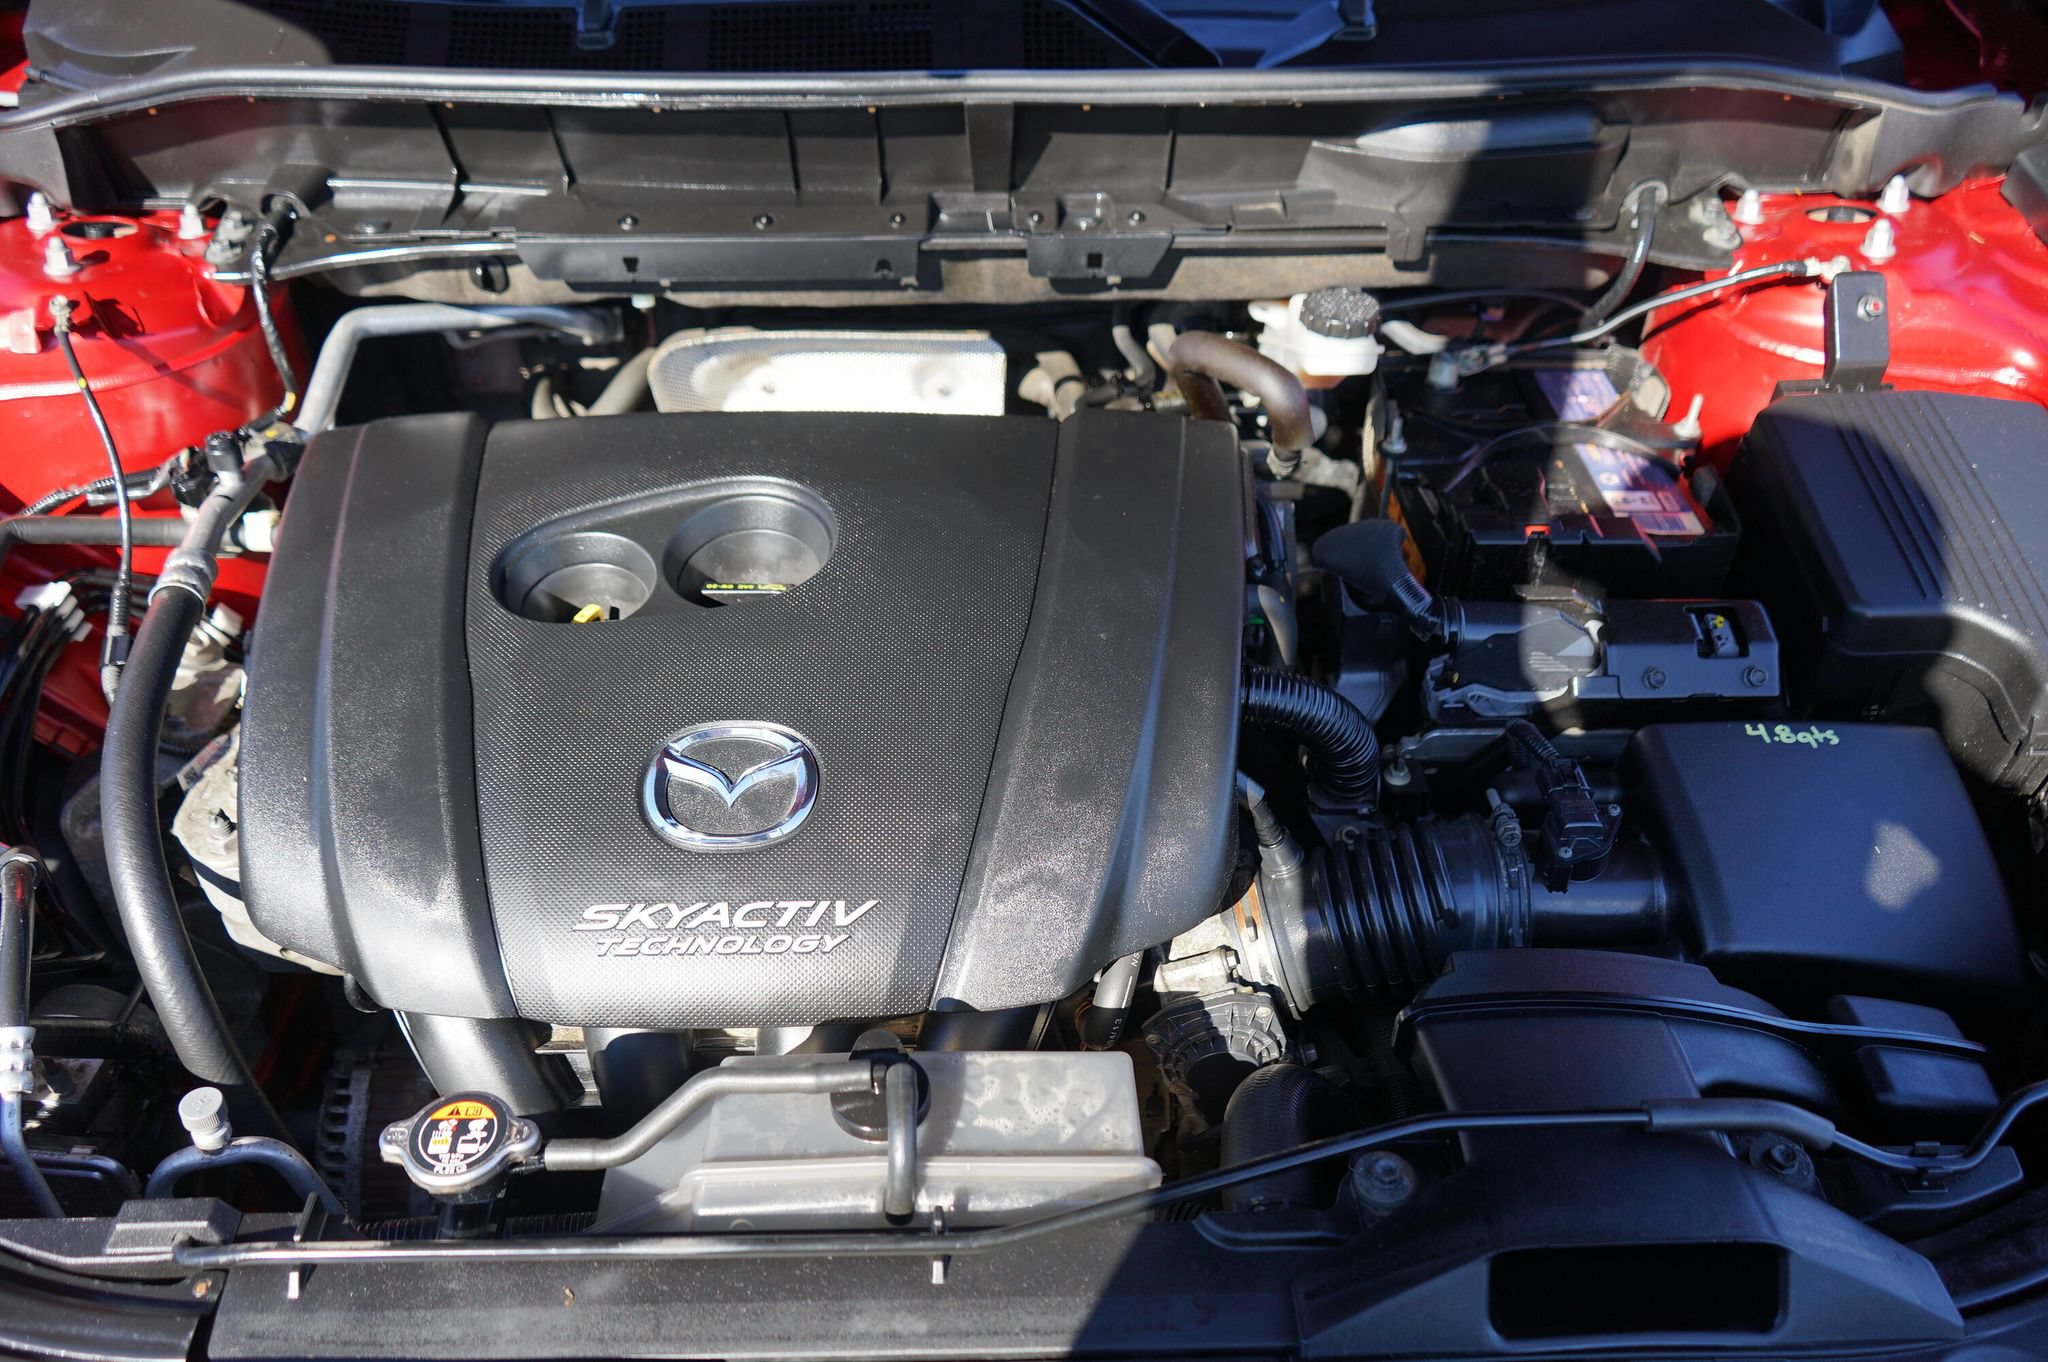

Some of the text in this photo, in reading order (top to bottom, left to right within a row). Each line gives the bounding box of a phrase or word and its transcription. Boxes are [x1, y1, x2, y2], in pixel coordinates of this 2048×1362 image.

[1744, 723, 1840, 749] 4.8qts
[572, 899, 881, 932] SKYACTIV
[595, 934, 852, 957] TECHNOLOGY
